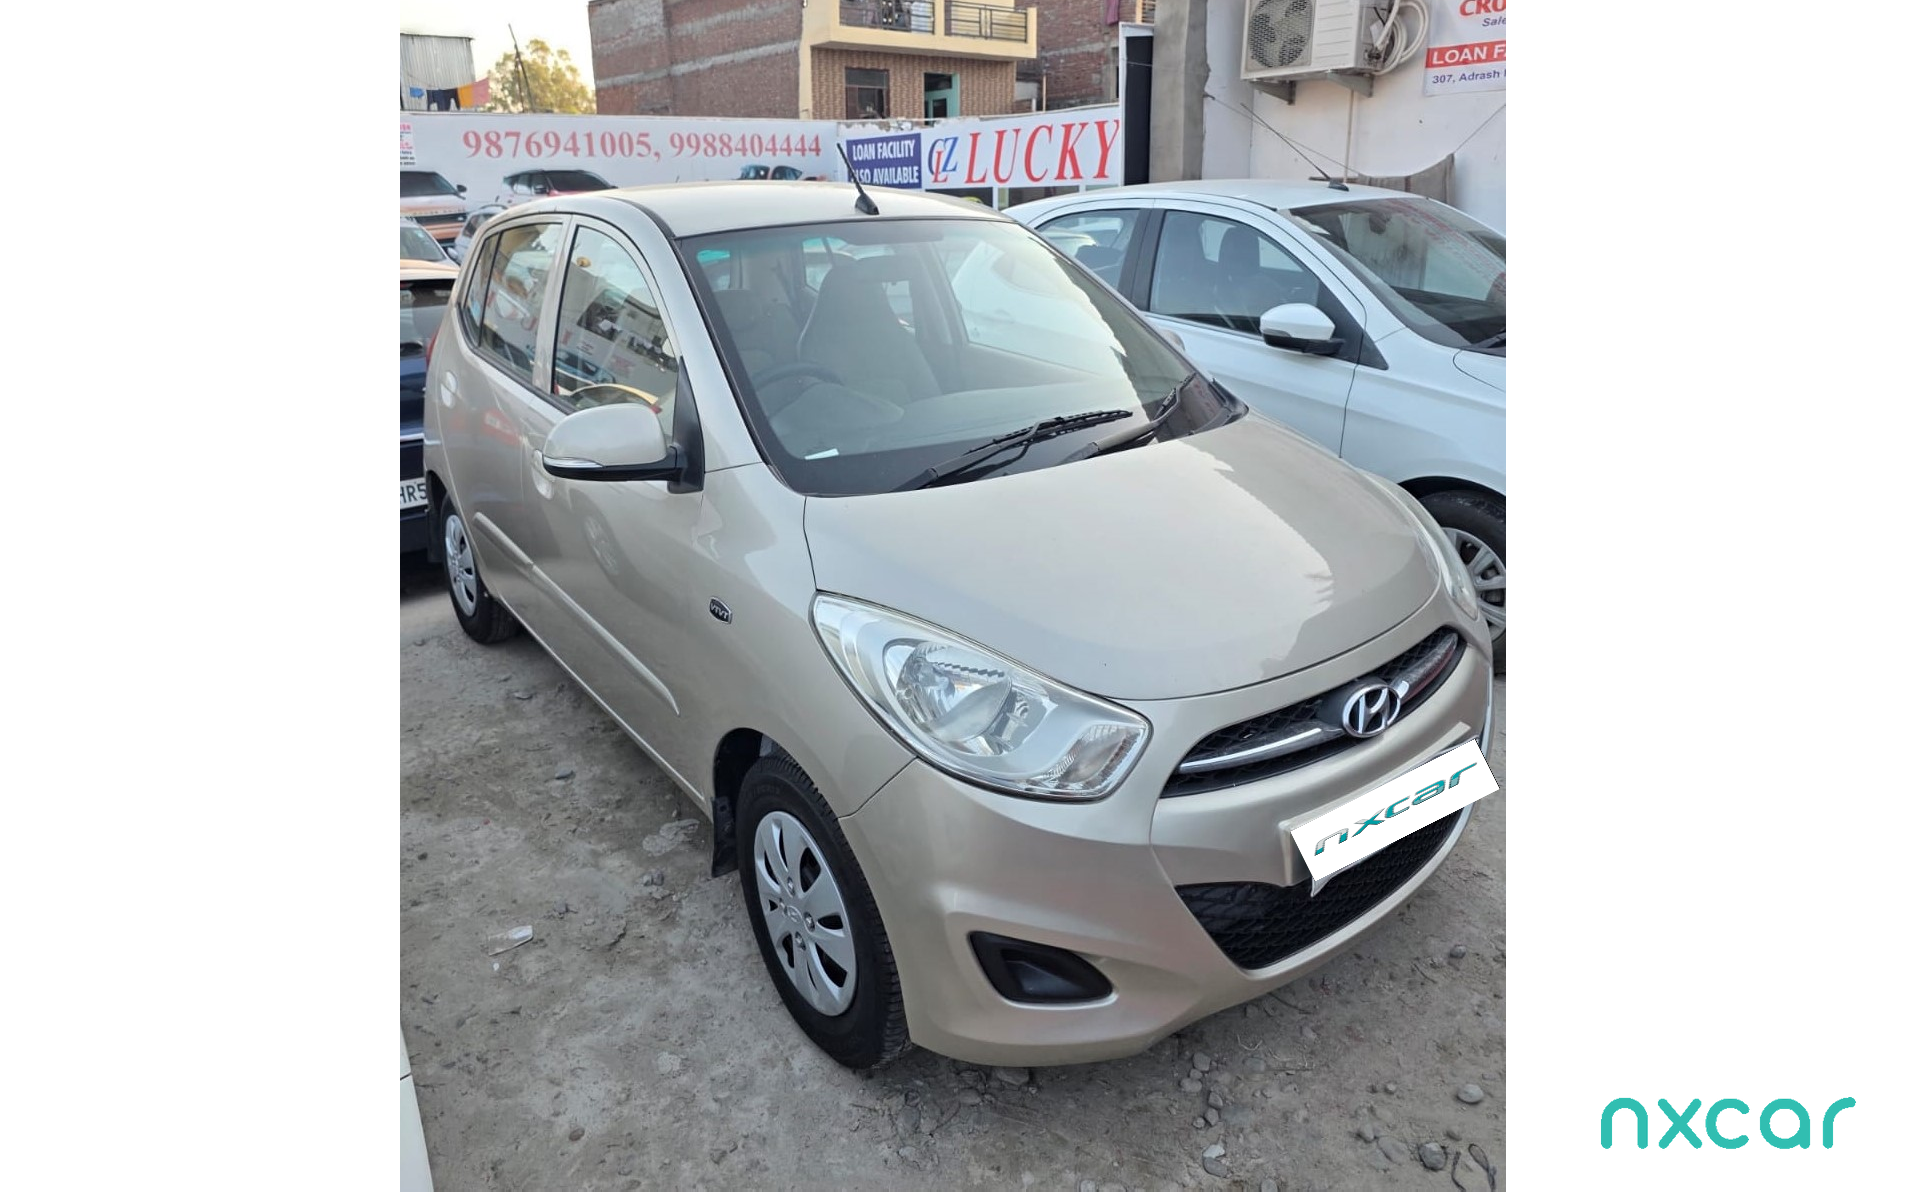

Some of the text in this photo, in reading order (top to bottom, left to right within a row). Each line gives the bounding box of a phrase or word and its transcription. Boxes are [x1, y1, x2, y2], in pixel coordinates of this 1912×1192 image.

[1482, 16, 1506, 27] Sale
[1432, 46, 1487, 65] LOAN
[1432, 74, 1455, 84] 307,
[1459, 70, 1500, 82] Adrash
[462, 130, 822, 162] 9876941005, 9988404444
[852, 140, 915, 161] LOAN FACILITY
[964, 119, 1120, 184] LUCKY
[850, 166, 919, 184] LSO AVAILABLE
